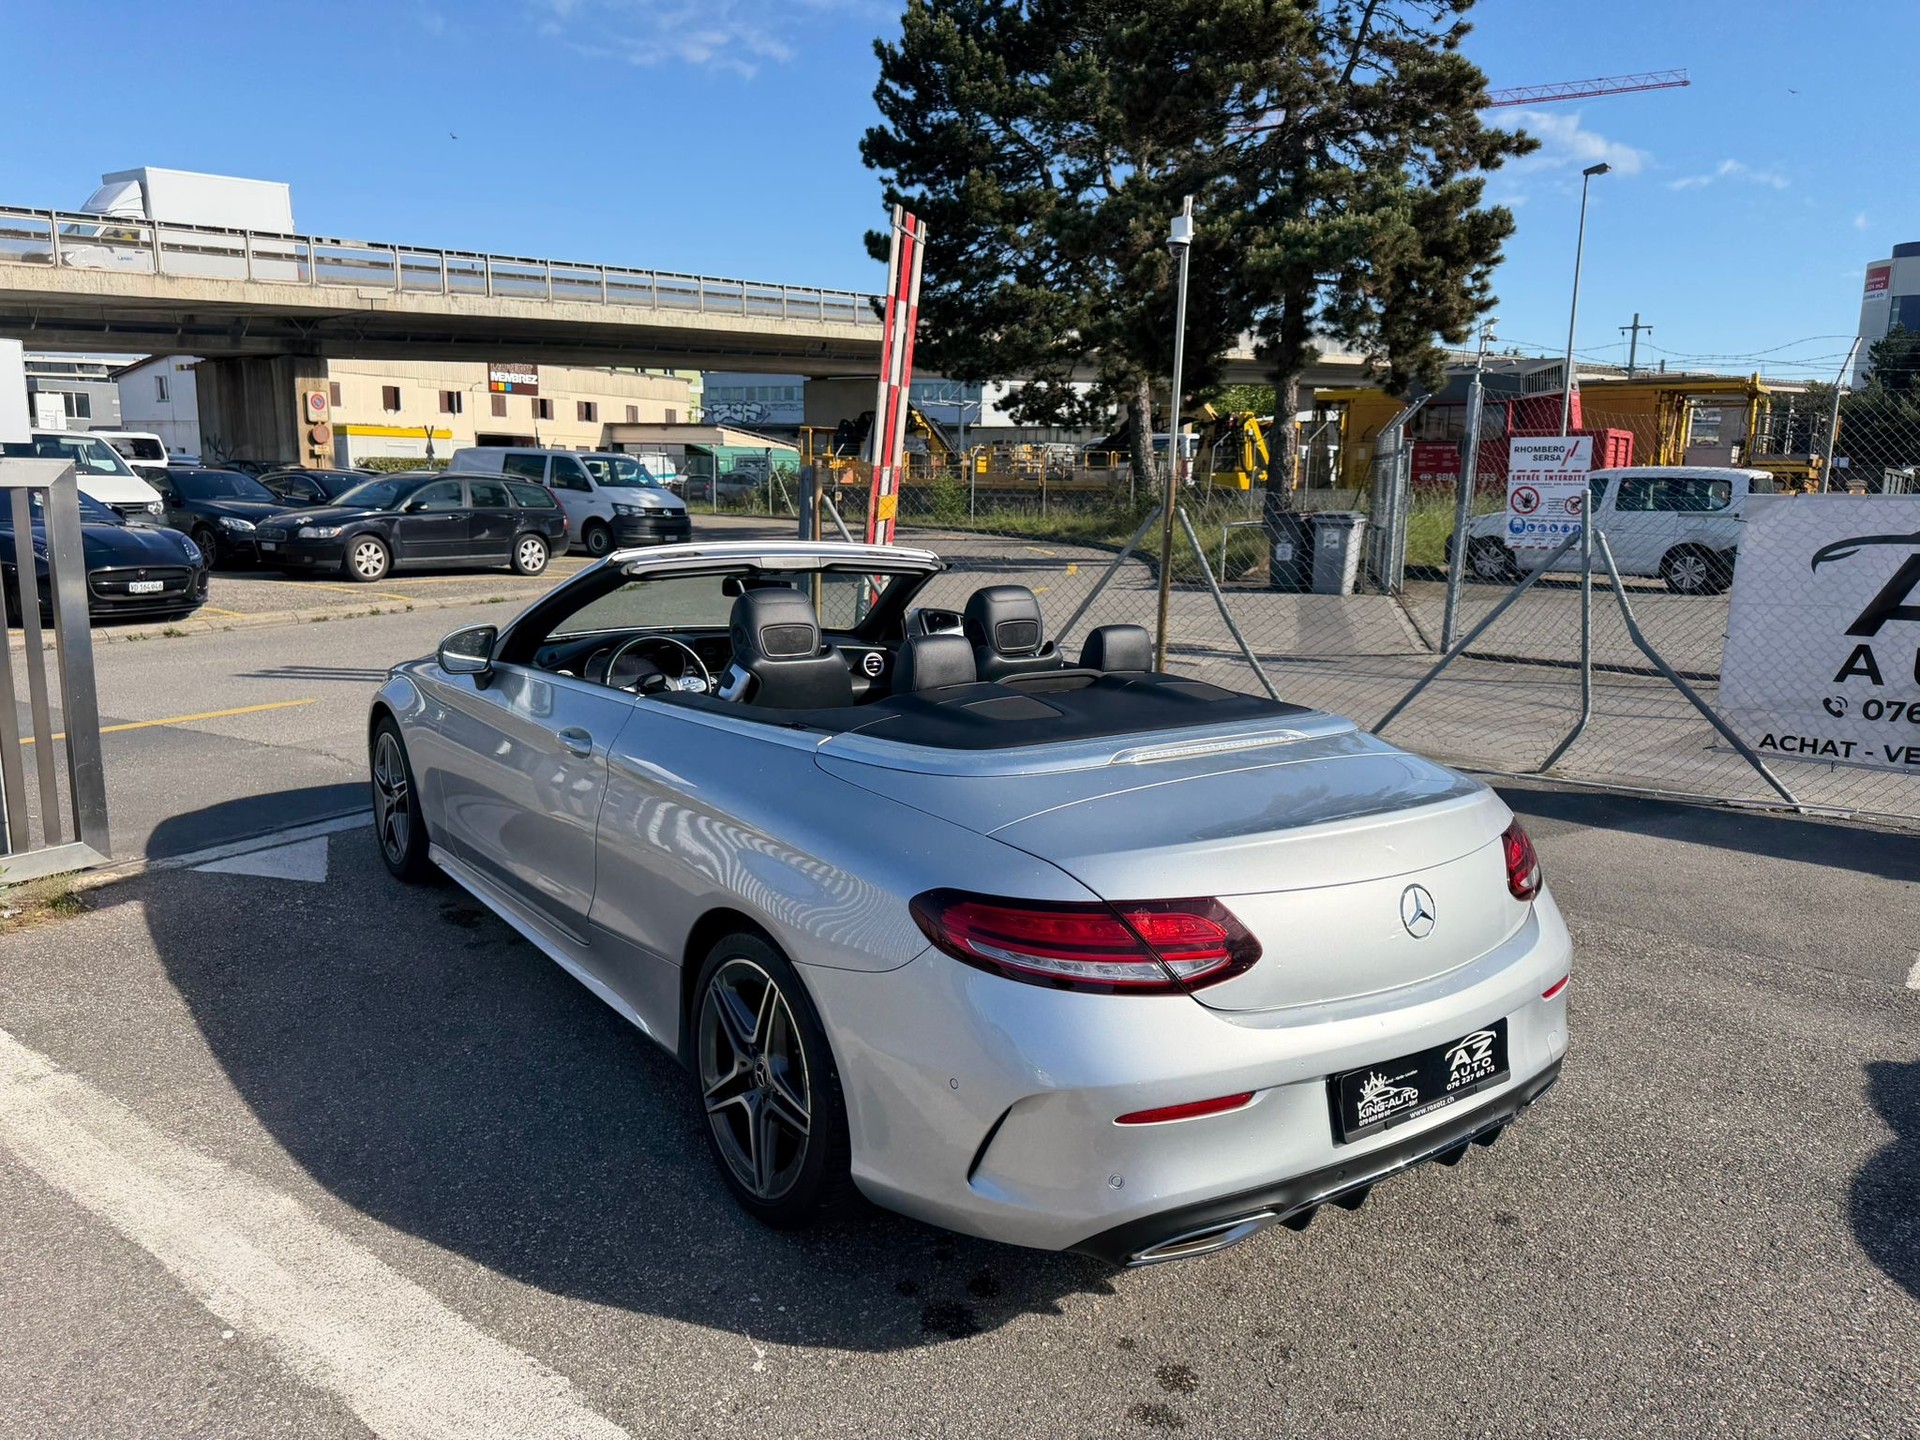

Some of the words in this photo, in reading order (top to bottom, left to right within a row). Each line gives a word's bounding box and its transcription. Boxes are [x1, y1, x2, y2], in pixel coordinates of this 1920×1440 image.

[490, 371, 538, 385] MEMBREZ
[1512, 473, 1540, 481] ENTRÉE
[1862, 699, 1920, 724] 076
[1759, 733, 1857, 758] ACHAT
[1450, 1038, 1492, 1071] AZ
[1446, 1080, 1460, 1091] 076
[1461, 1074, 1474, 1085] 227
[1486, 1065, 1495, 1074] 73
[1450, 1057, 1491, 1081] AUTO
[1359, 1089, 1419, 1119] KING-AUTO
